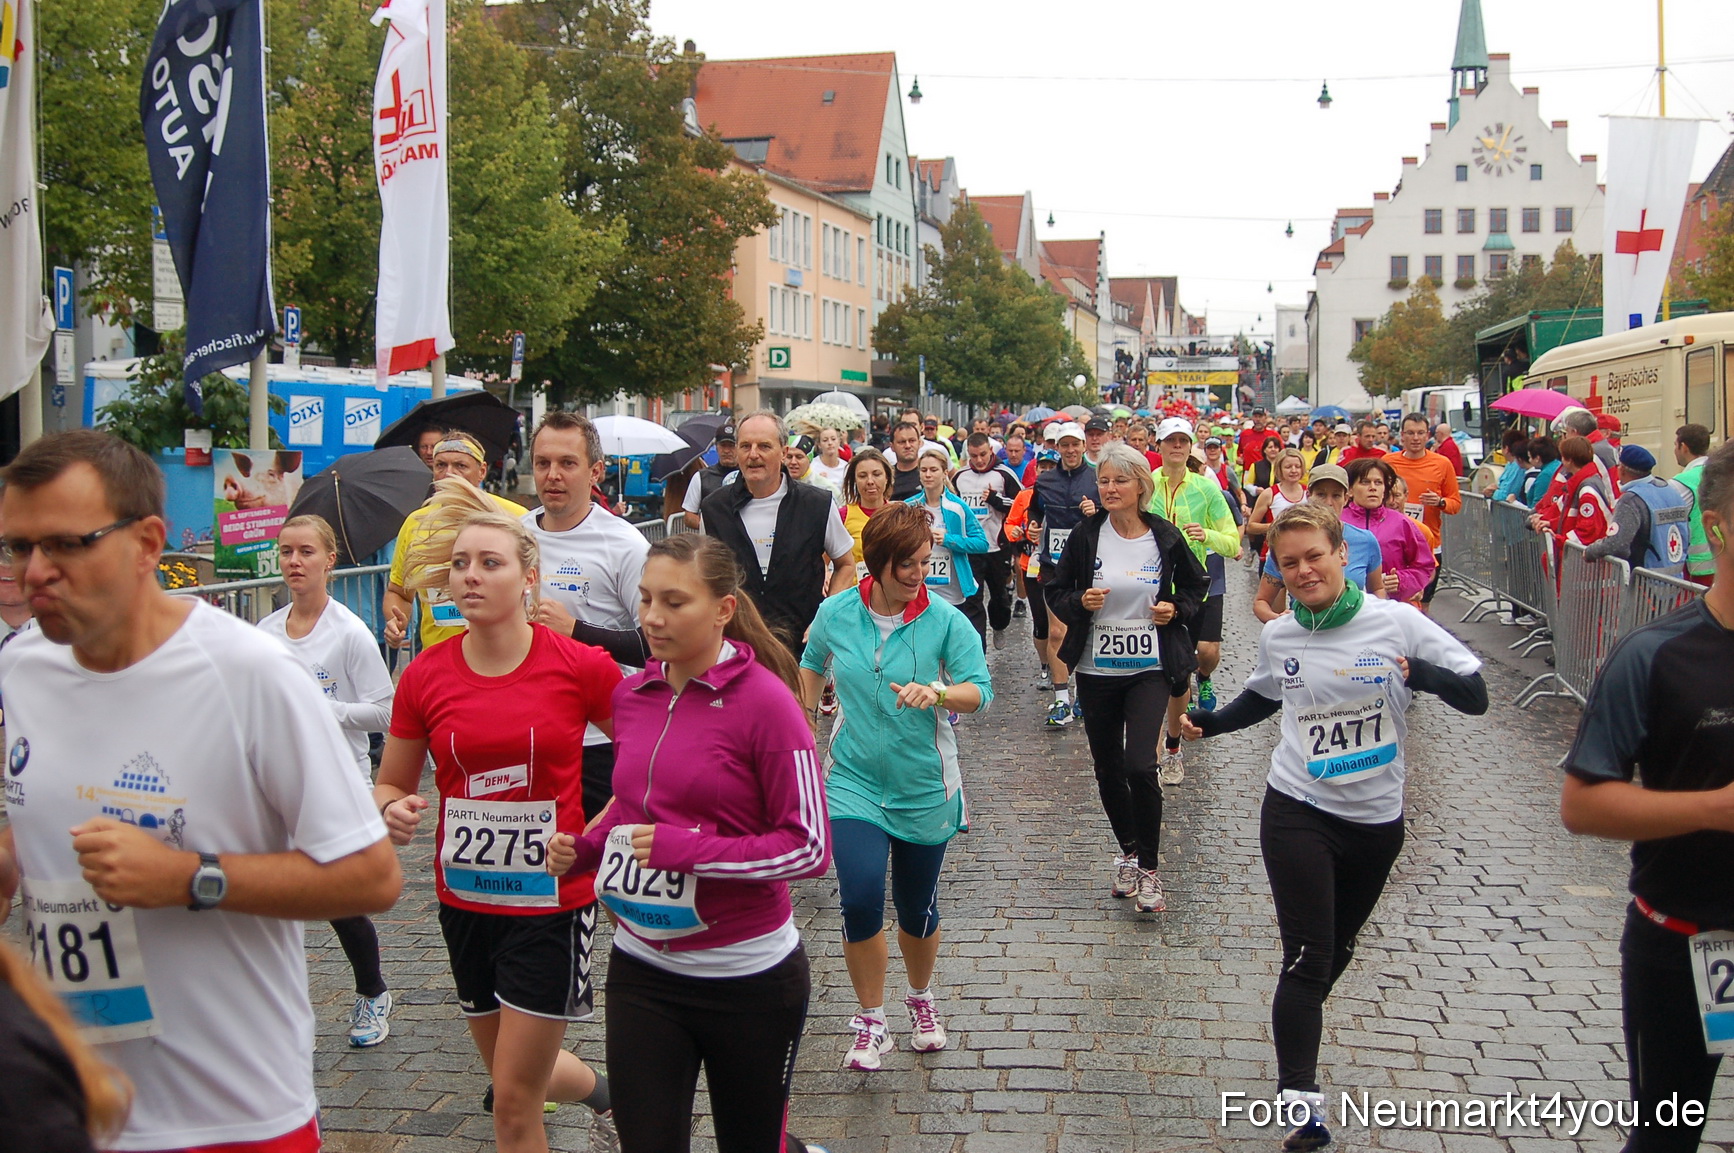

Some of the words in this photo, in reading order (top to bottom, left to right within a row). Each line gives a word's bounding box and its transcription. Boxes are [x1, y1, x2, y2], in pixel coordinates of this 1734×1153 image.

[59, 276, 70, 322] P
[288, 312, 297, 340] P
[771, 349, 788, 366] D
[1177, 374, 1208, 382] START
[1607, 366, 1659, 393] Bayerisches
[1607, 396, 1631, 414] Rotes
[223, 521, 245, 533] BEIDE
[243, 528, 265, 539] GRÜN
[1053, 537, 1066, 551] 24
[930, 561, 947, 575] 12
[449, 608, 463, 617] Ma
[1095, 624, 1114, 632] PARTL
[1099, 633, 1152, 655] 2509
[1111, 659, 1141, 668] Kerstin
[1284, 676, 1305, 685] PARTL
[1298, 713, 1329, 723] PARTL
[1330, 705, 1372, 718] Neumarkt
[1309, 712, 1382, 755] 2477
[1328, 754, 1380, 774] Johanna
[484, 774, 510, 788] DEHN
[447, 809, 480, 821] PARTL
[482, 811, 535, 823] Neumarkt
[452, 826, 546, 867] 2275
[608, 834, 631, 846] ARTL
[603, 851, 685, 899] 2029
[474, 875, 523, 892] Annika
[36, 899, 99, 914] Neumarkt
[622, 903, 672, 926] Andreas
[1694, 939, 1734, 953] PART
[1709, 958, 1734, 1005] 2
